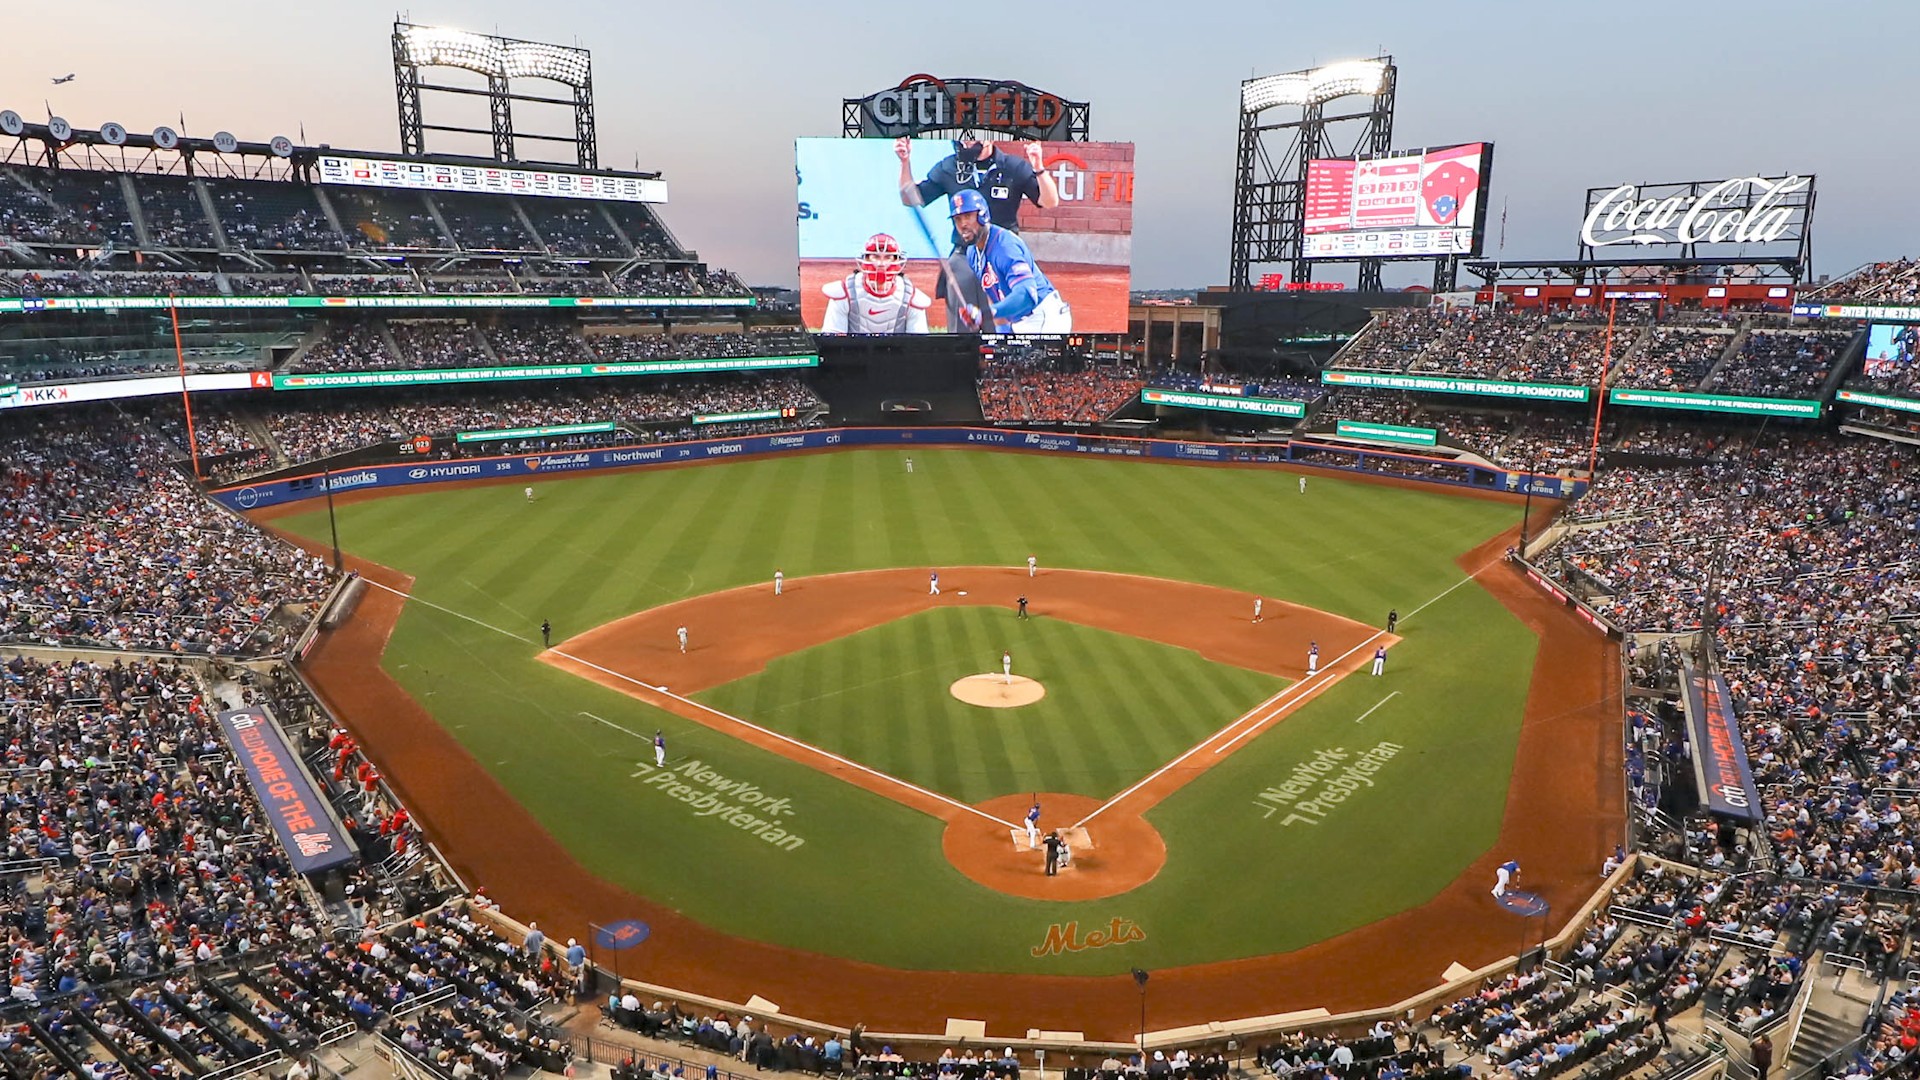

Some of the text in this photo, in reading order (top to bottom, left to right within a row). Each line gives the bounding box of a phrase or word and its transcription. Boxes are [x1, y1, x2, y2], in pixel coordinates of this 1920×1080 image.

[873, 82, 1061, 127] citi FIELD
[5, 115, 17, 128] 14
[53, 123, 66, 135] 37
[275, 141, 288, 152] 42
[1381, 183, 1392, 192] 22
[1842, 306, 1909, 319] ENTER THE METS
[256, 374, 267, 386] 4
[325, 376, 358, 386] COULD
[358, 375, 379, 384] WIN
[414, 373, 440, 382] WHEN
[441, 372, 458, 381] THE
[458, 371, 479, 380] METS
[479, 371, 494, 379] HIT
[501, 369, 526, 378] HOME
[526, 369, 543, 377] RUN
[551, 367, 567, 376] THE
[567, 367, 582, 375] 4TH
[1373, 376, 1390, 386] THE
[1390, 377, 1415, 388] METS
[1415, 378, 1448, 390] SWING
[1448, 379, 1457, 390] 4
[1457, 382, 1476, 392] THE
[1476, 383, 1516, 394] FENCES
[1516, 385, 1584, 400] PROMOTION
[1161, 394, 1302, 416] SPONSORED BY NEW YORK LOTTERY
[1763, 402, 1814, 414] PROMOTION
[777, 435, 805, 446] National
[826, 434, 840, 443] citi
[976, 434, 1005, 443] DELTA
[400, 441, 413, 451] citi
[706, 443, 742, 456] verizon
[613, 449, 662, 463] Northwell
[679, 449, 690, 458] 370
[430, 465, 481, 478] HYUNDAI
[496, 462, 511, 471] 358
[230, 713, 258, 731] citi
[239, 726, 266, 753] FIELD
[251, 744, 287, 784] HOME
[1294, 741, 1404, 818] Presbyterian
[268, 780, 298, 802] OF
[1717, 784, 1749, 808] citi
[280, 800, 316, 833] THE
[643, 770, 806, 851] Presbyterian
[1031, 916, 1147, 958] Mets
